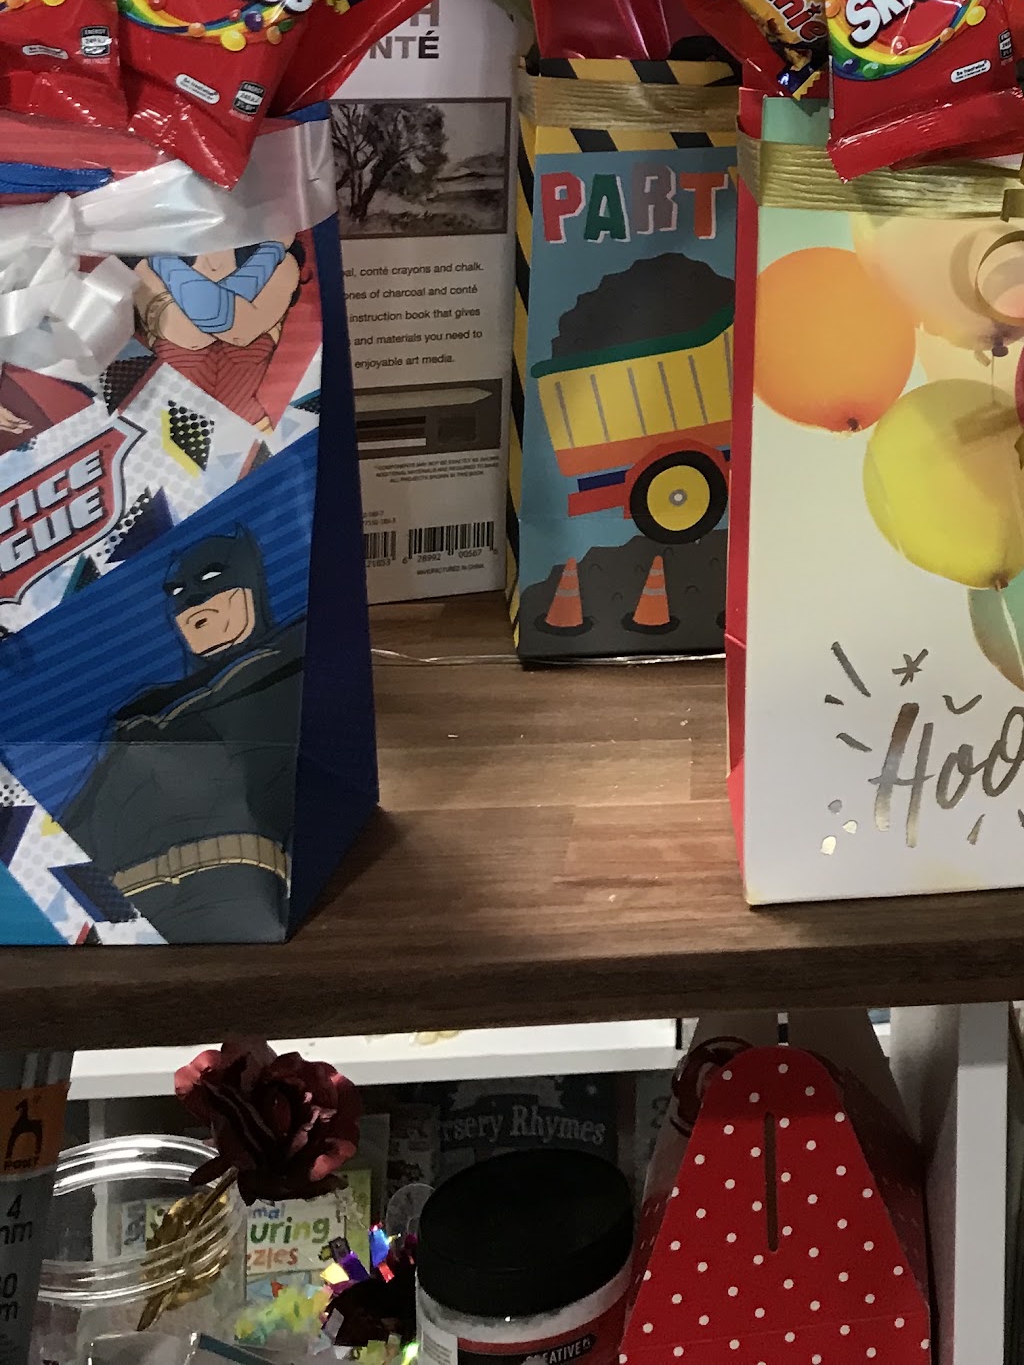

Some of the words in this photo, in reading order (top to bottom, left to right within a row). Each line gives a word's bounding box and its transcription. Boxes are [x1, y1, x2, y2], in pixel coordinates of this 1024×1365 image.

[541, 162, 728, 245] PART
[360, 267, 388, 276] conté
[391, 265, 431, 277] crayons
[434, 263, 453, 273] and
[454, 262, 484, 272] chalk.
[370, 290, 380, 299] of
[383, 286, 426, 298] charcoal
[428, 286, 447, 296] and
[450, 284, 478, 295] conté
[349, 311, 402, 323] instruction
[405, 309, 430, 319] book
[433, 308, 452, 318] that
[454, 308, 481, 319] gives
[354, 336, 373, 346] and
[376, 333, 422, 345] materials
[424, 333, 443, 343] you
[445, 330, 470, 340] need
[473, 330, 483, 338] to
[354, 357, 403, 370] enjoyable
[406, 356, 419, 365] art
[422, 354, 454, 364] media.
[510, 1104, 606, 1145] Rhymes
